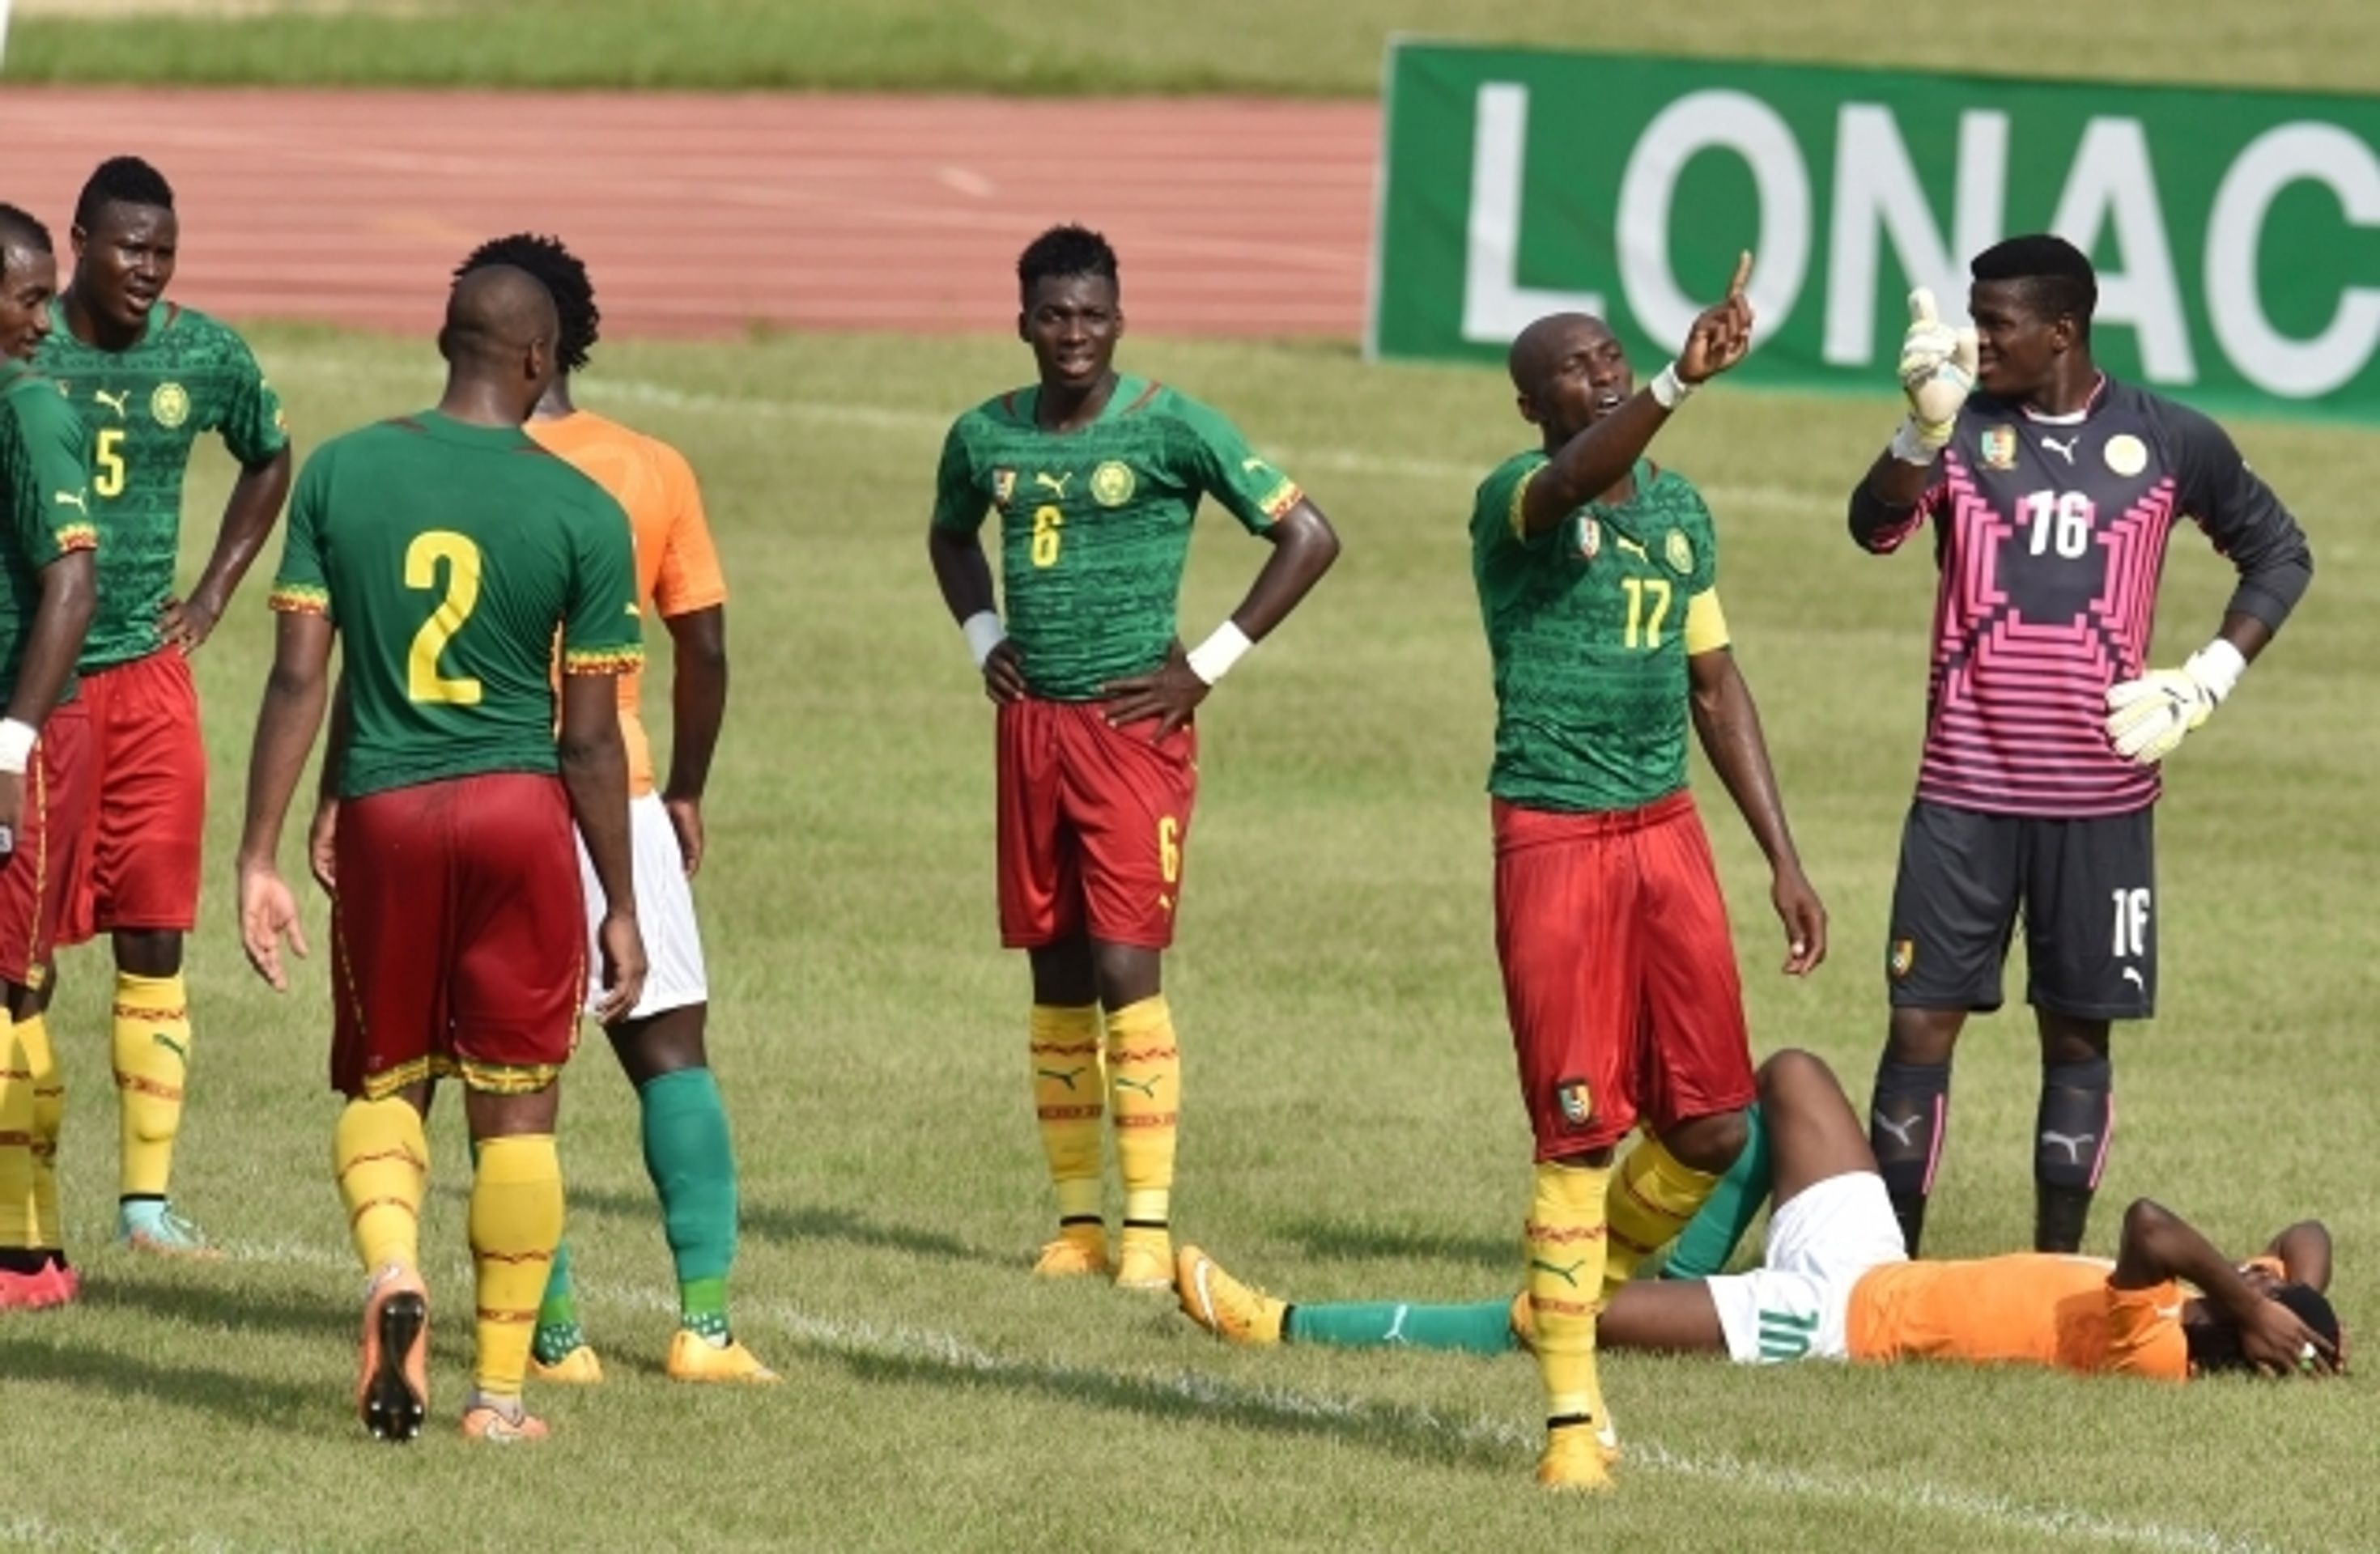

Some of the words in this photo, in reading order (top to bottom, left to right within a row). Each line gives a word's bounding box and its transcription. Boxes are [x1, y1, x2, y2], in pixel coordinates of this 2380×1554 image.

[1460, 82, 2380, 398] LONAC
[94, 430, 125, 498] 5
[1031, 505, 1062, 567] 6
[2027, 490, 2089, 559] 16
[404, 530, 482, 704] 2
[1621, 577, 1672, 649] 17
[1159, 816, 1179, 883] 6
